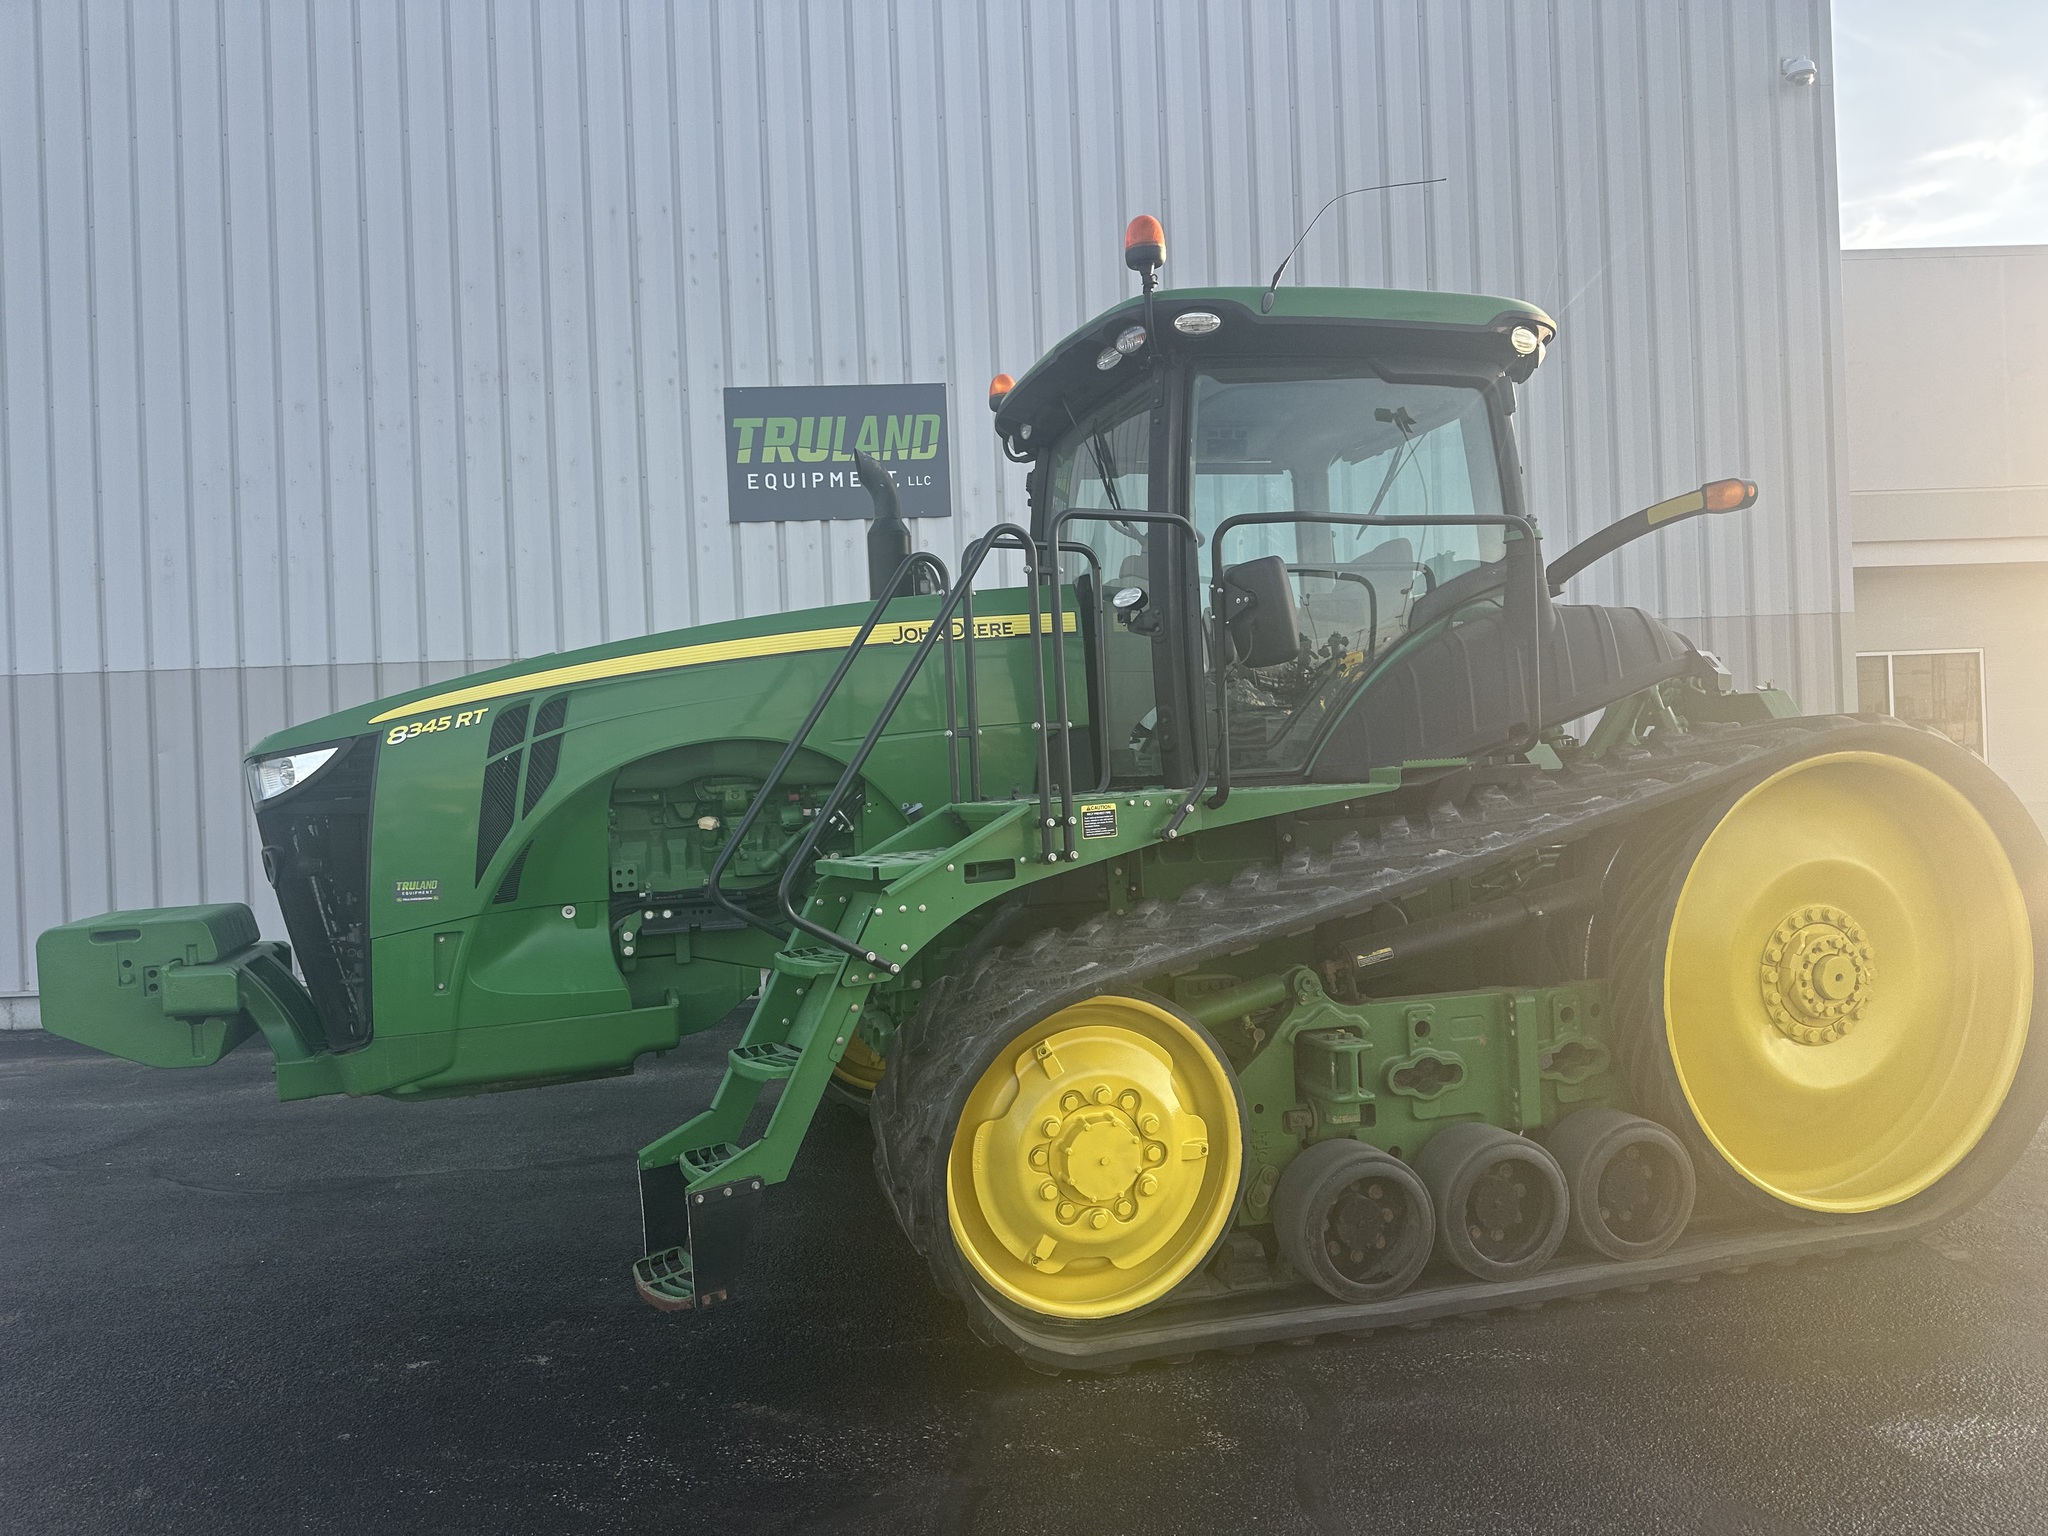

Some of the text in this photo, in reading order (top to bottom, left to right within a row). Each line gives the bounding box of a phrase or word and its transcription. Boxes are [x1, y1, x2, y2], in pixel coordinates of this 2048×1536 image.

[732, 414, 941, 464] TRULAND
[747, 471, 932, 490] EQUIPMET, LLC
[892, 622, 1014, 642] JOH DERE
[386, 707, 489, 745] 8345 RT
[396, 880, 438, 891] TRULAND
